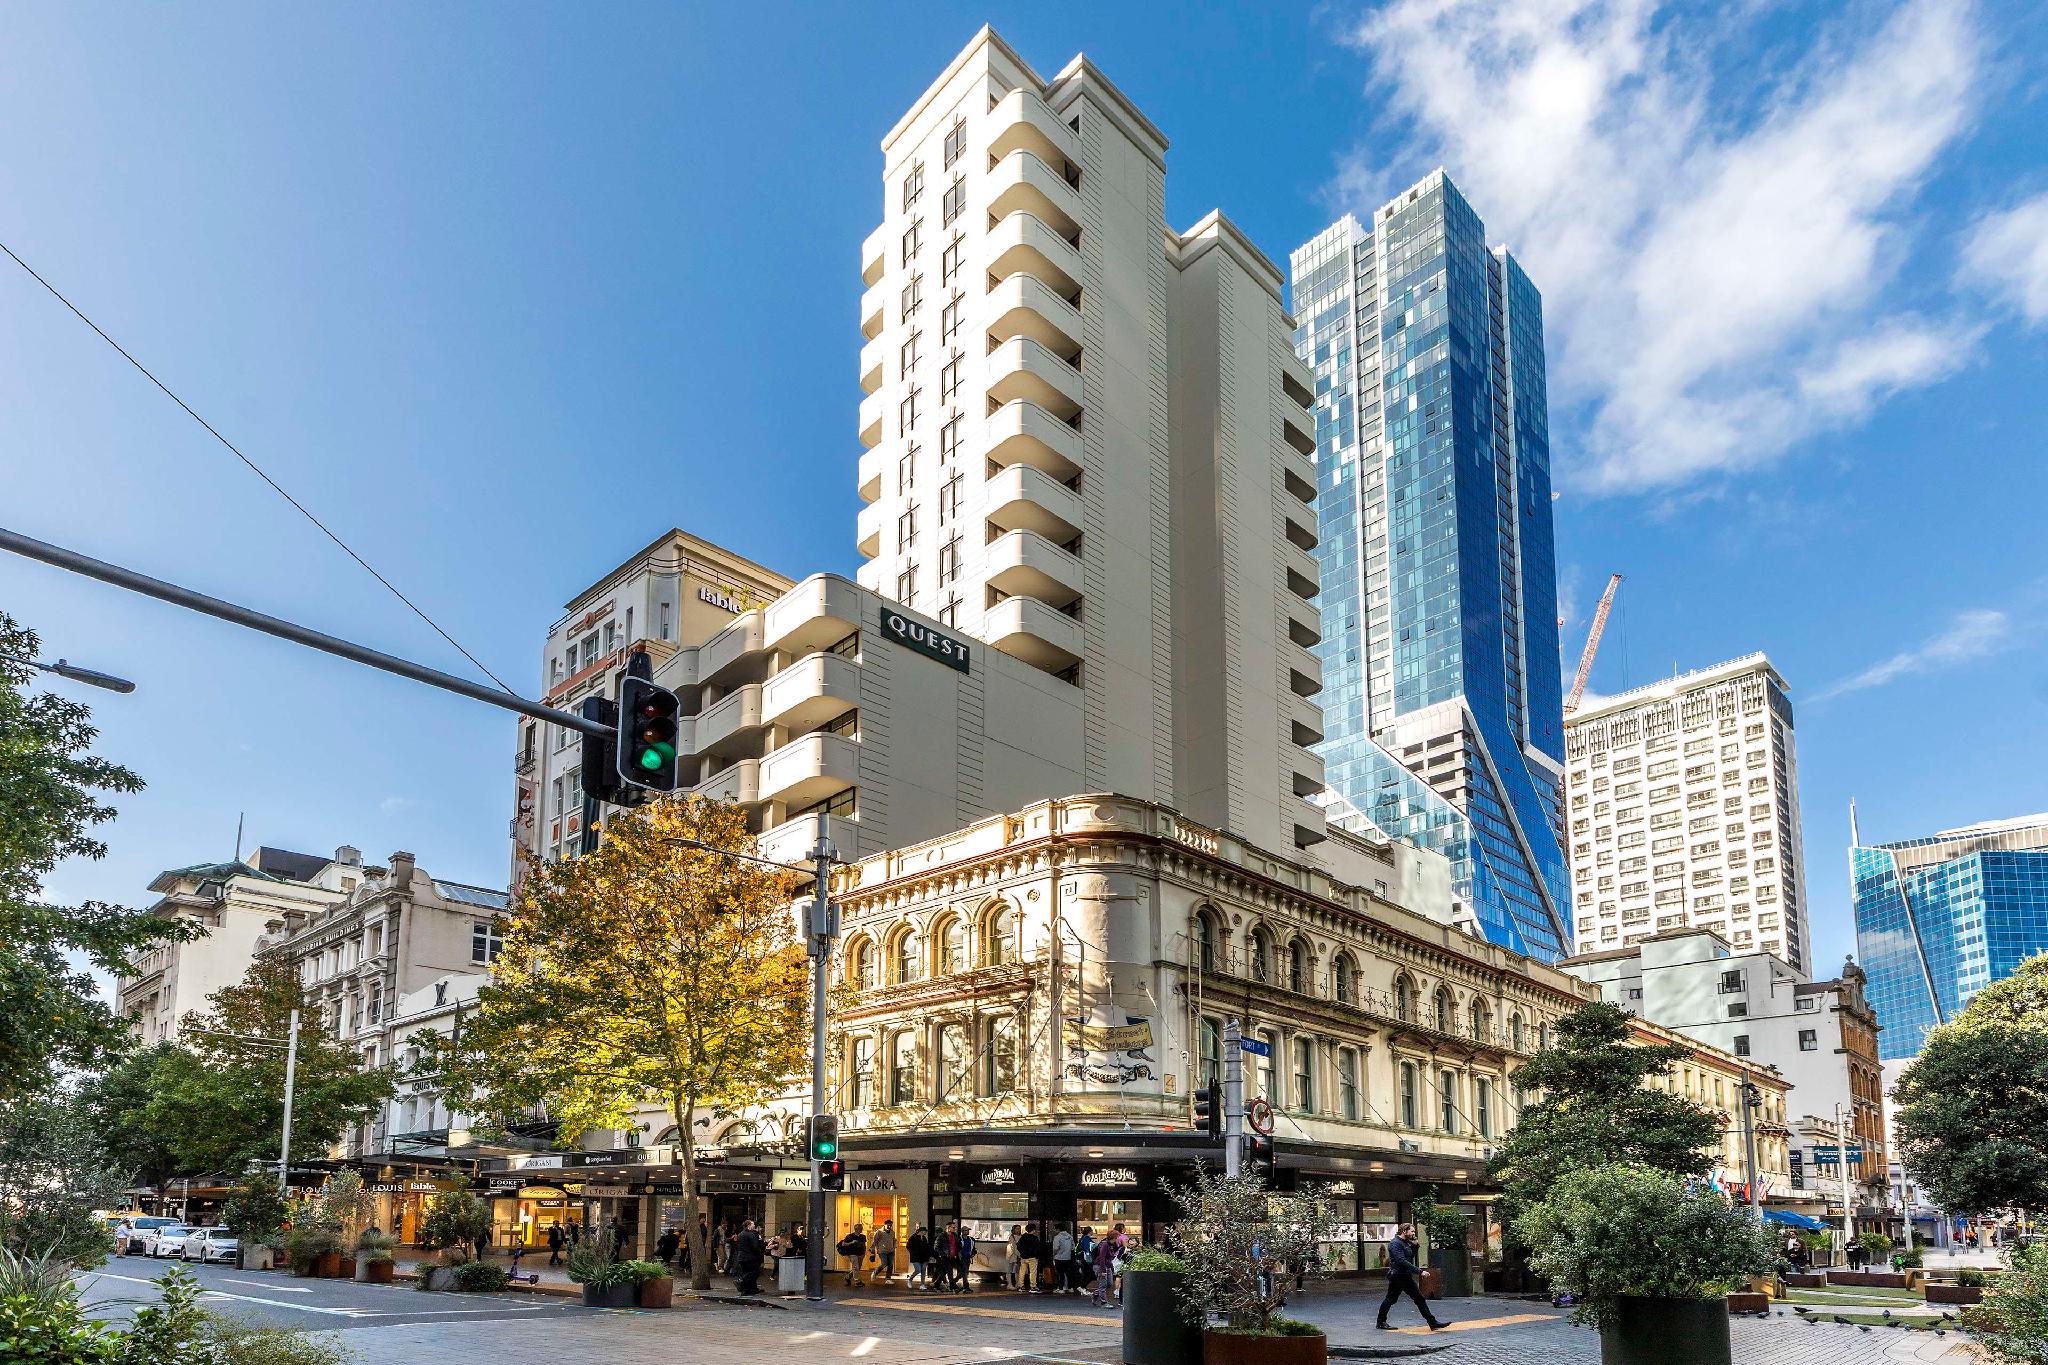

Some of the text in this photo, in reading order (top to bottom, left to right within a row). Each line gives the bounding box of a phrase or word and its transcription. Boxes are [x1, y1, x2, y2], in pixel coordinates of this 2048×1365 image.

[887, 615, 966, 661] QUEST
[325, 924, 359, 942] BUILDINGS
[1082, 1168, 1116, 1186] WALKER
[1117, 1167, 1137, 1181] HALL
[372, 1184, 403, 1192] LOUIS
